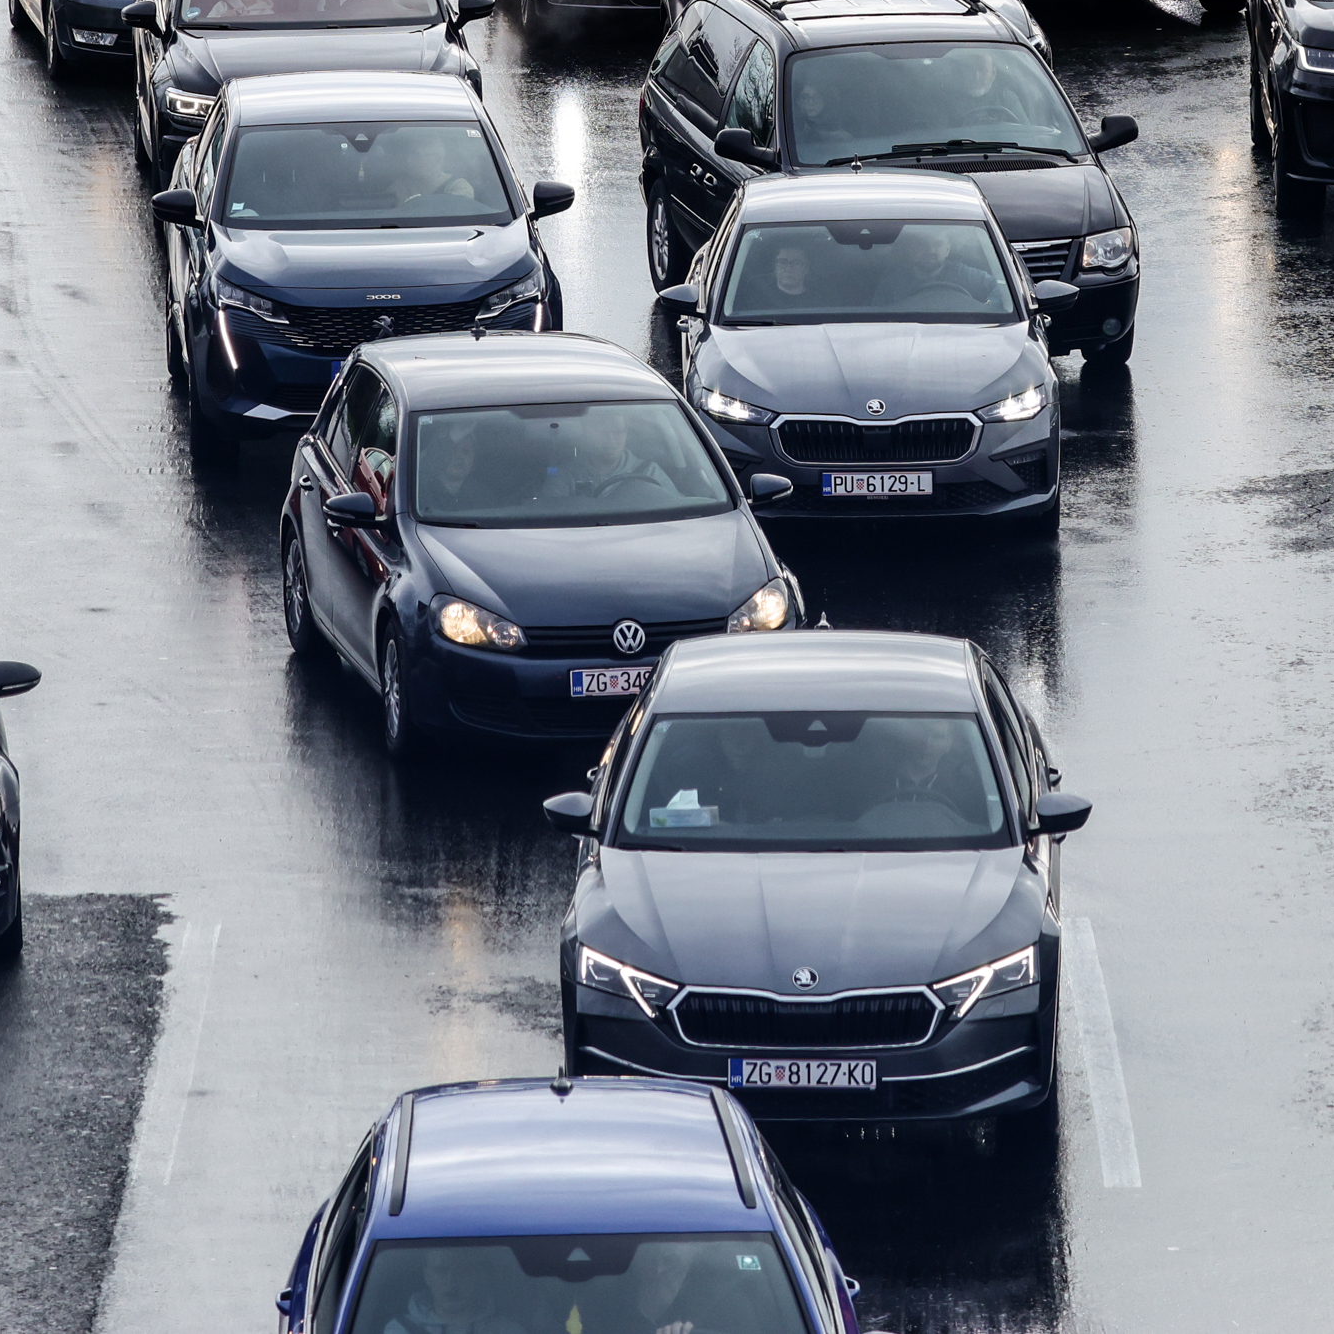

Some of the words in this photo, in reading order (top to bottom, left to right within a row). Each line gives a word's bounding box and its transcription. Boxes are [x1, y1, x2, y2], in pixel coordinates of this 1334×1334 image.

[834, 475, 854, 494] PU
[866, 475, 926, 493] 6129-L
[585, 672, 608, 693] ZG
[731, 1075, 742, 1083] HR
[745, 1062, 773, 1085] ZG
